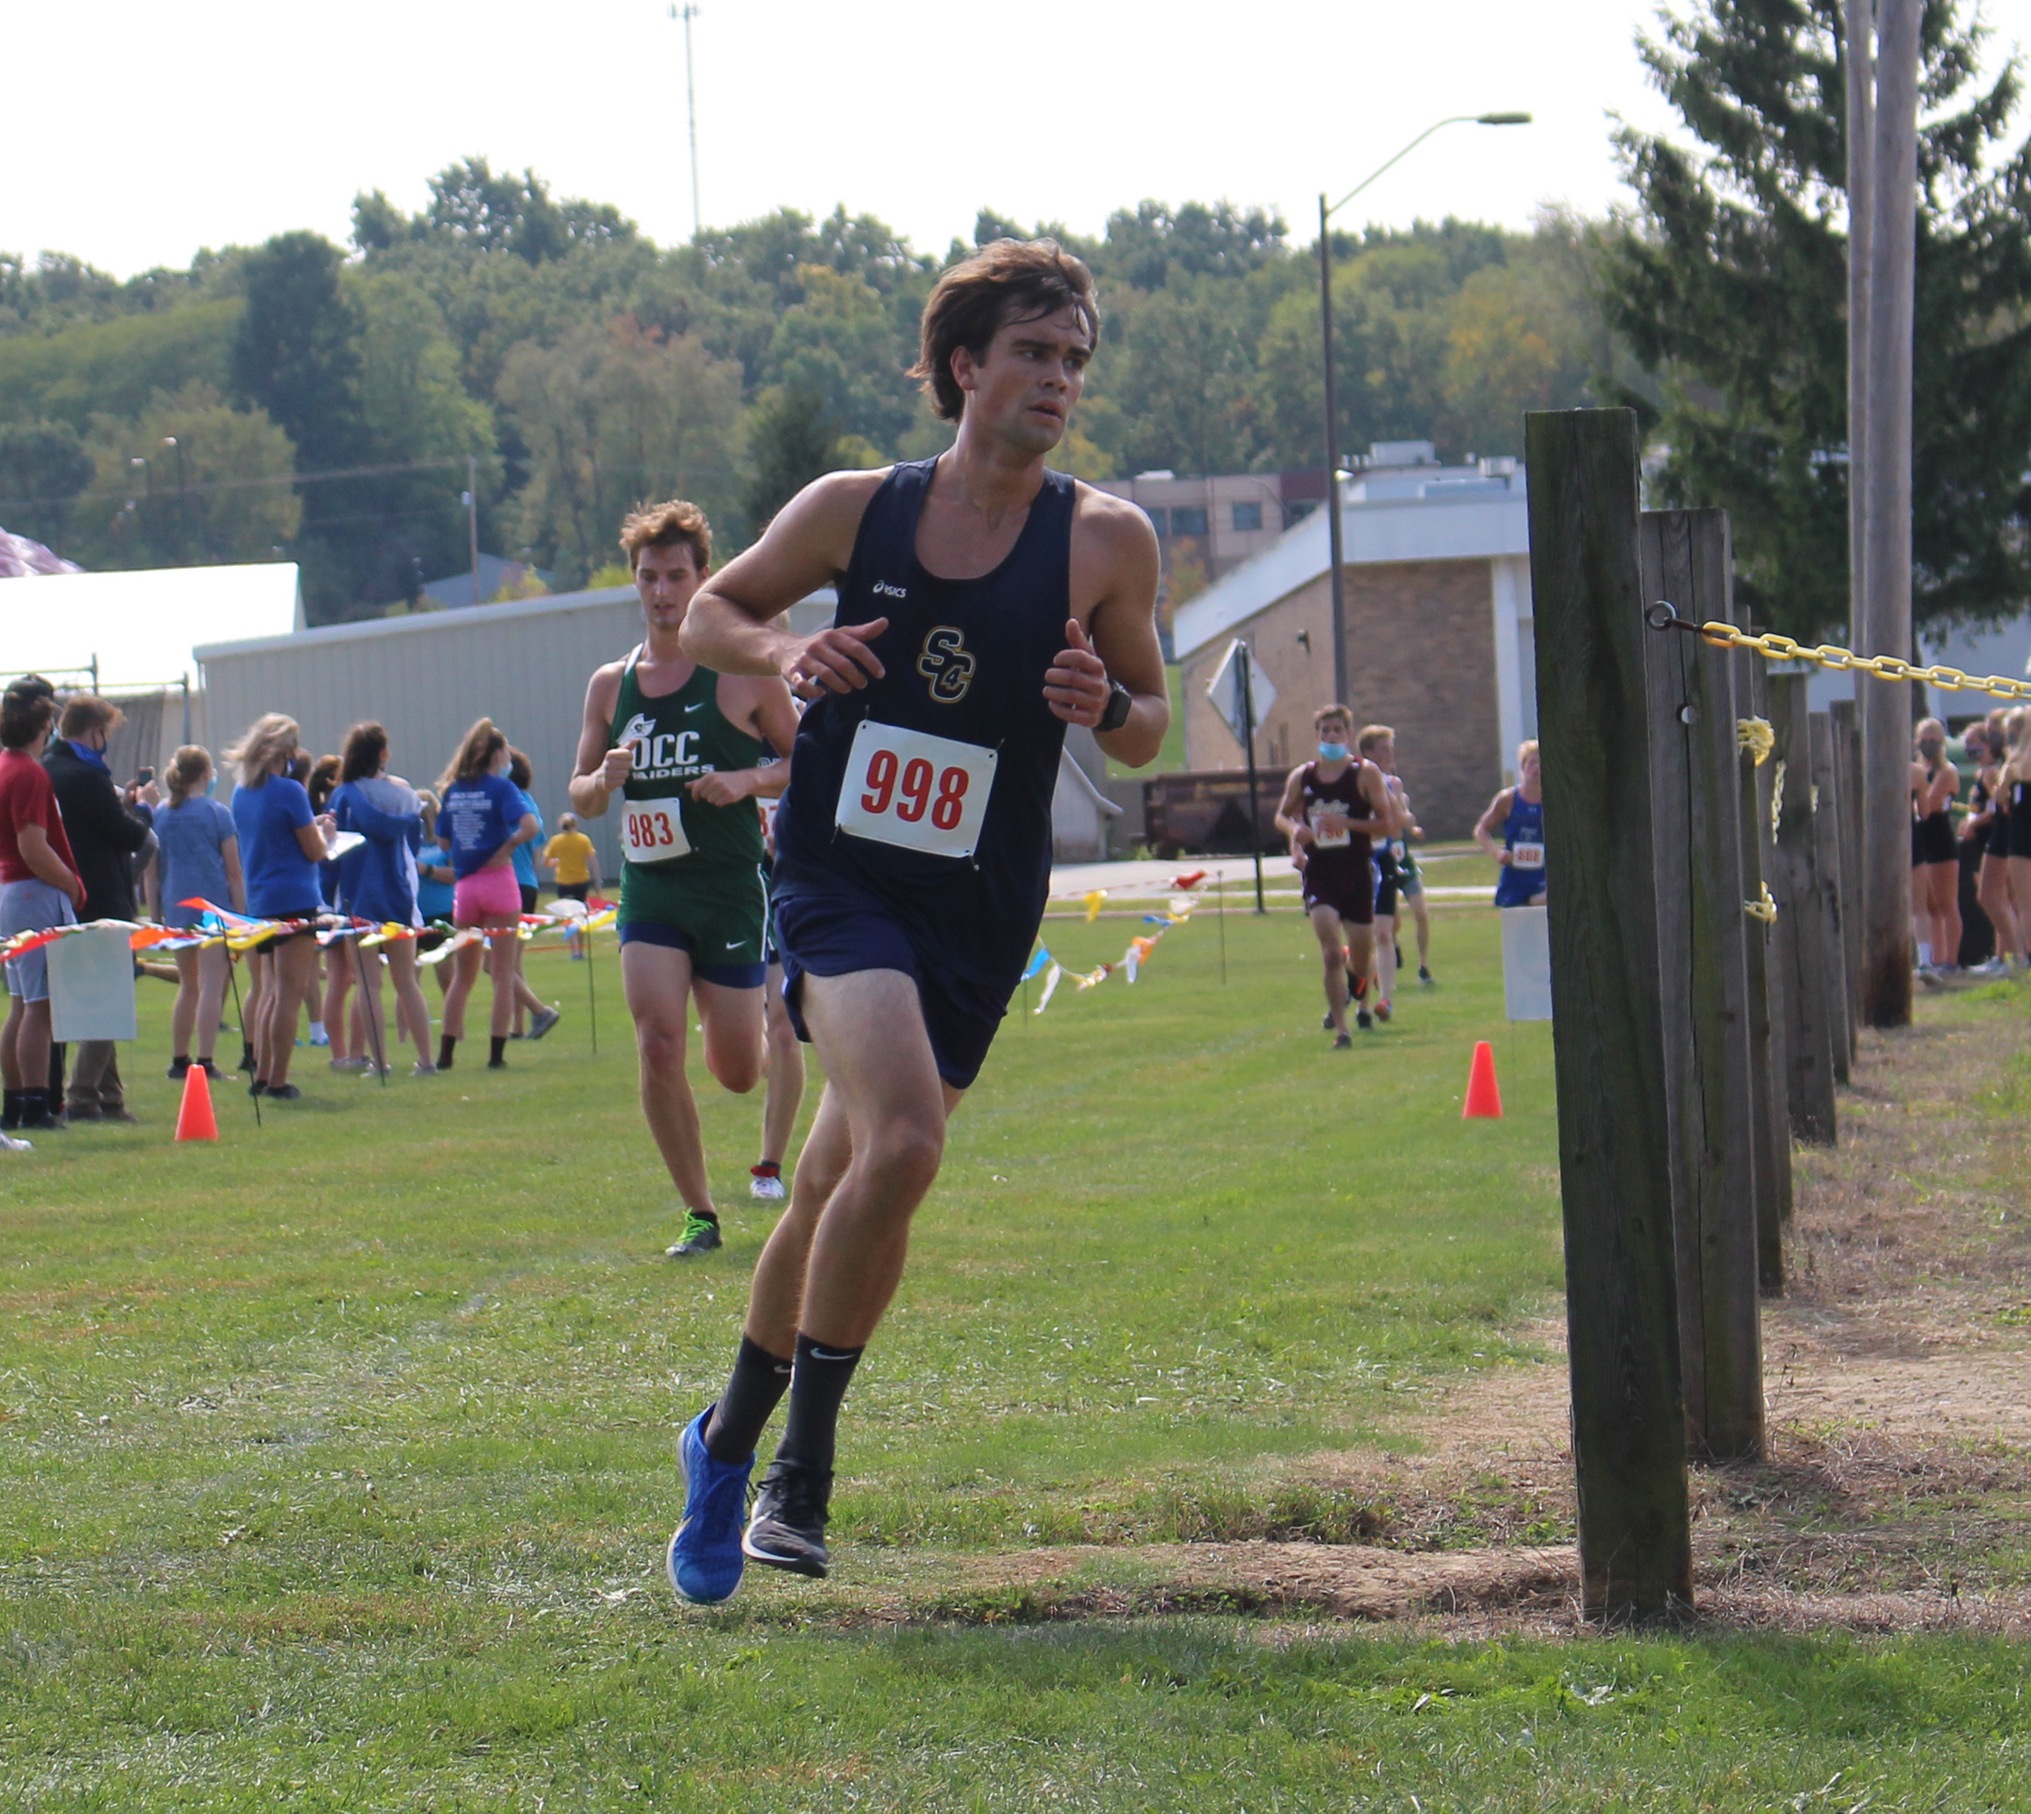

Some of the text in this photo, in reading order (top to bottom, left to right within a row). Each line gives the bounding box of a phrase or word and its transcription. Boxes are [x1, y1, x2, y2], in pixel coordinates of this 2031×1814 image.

[631, 730, 700, 771] OCC
[860, 749, 969, 830] 998
[628, 811, 674, 848] 983
